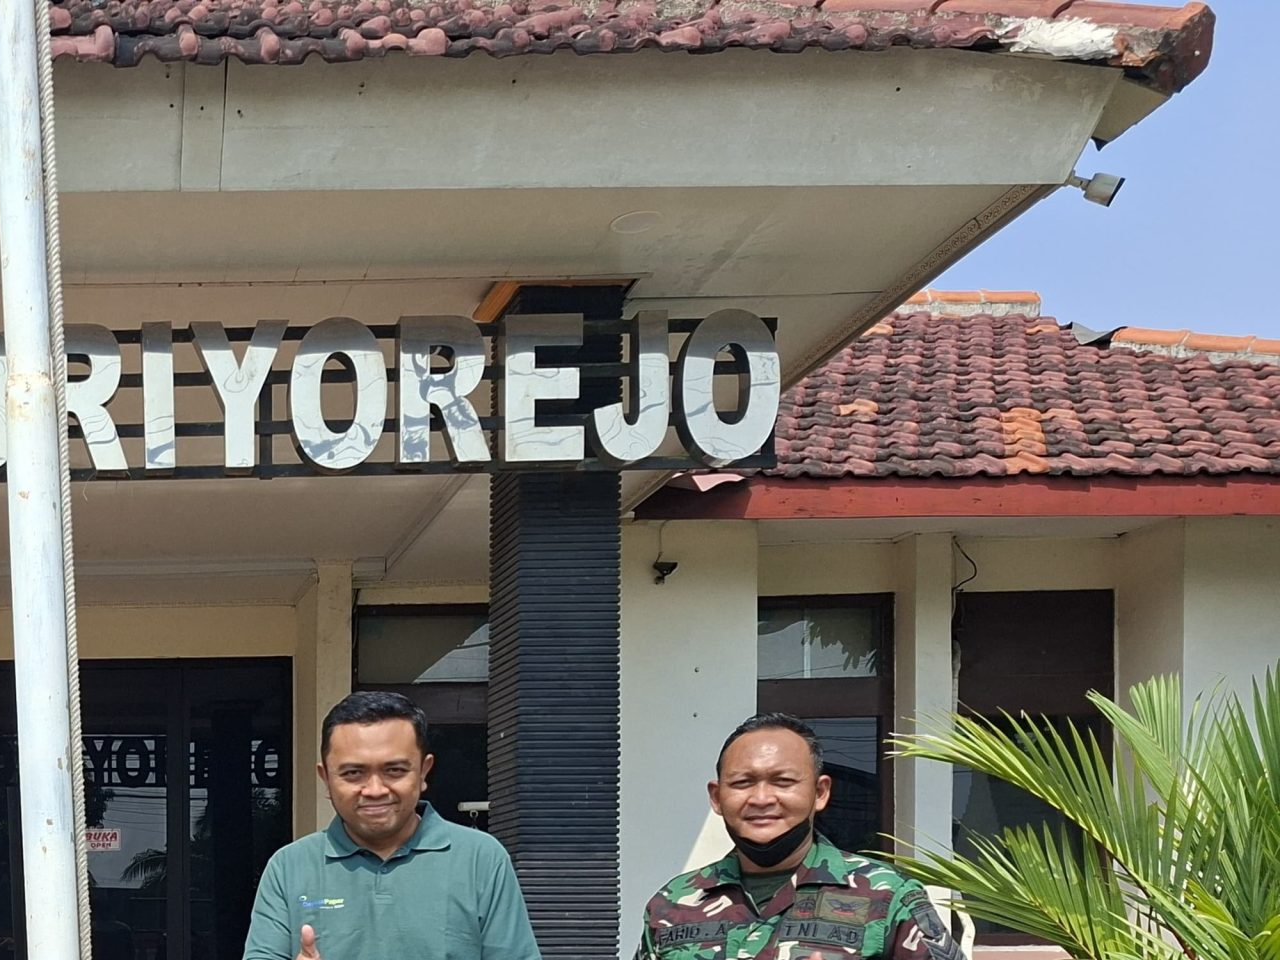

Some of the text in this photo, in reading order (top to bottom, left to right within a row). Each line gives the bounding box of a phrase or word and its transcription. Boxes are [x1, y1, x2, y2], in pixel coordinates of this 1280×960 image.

[85, 831, 118, 842] BUKA
[785, 922, 858, 944] TNI AD
